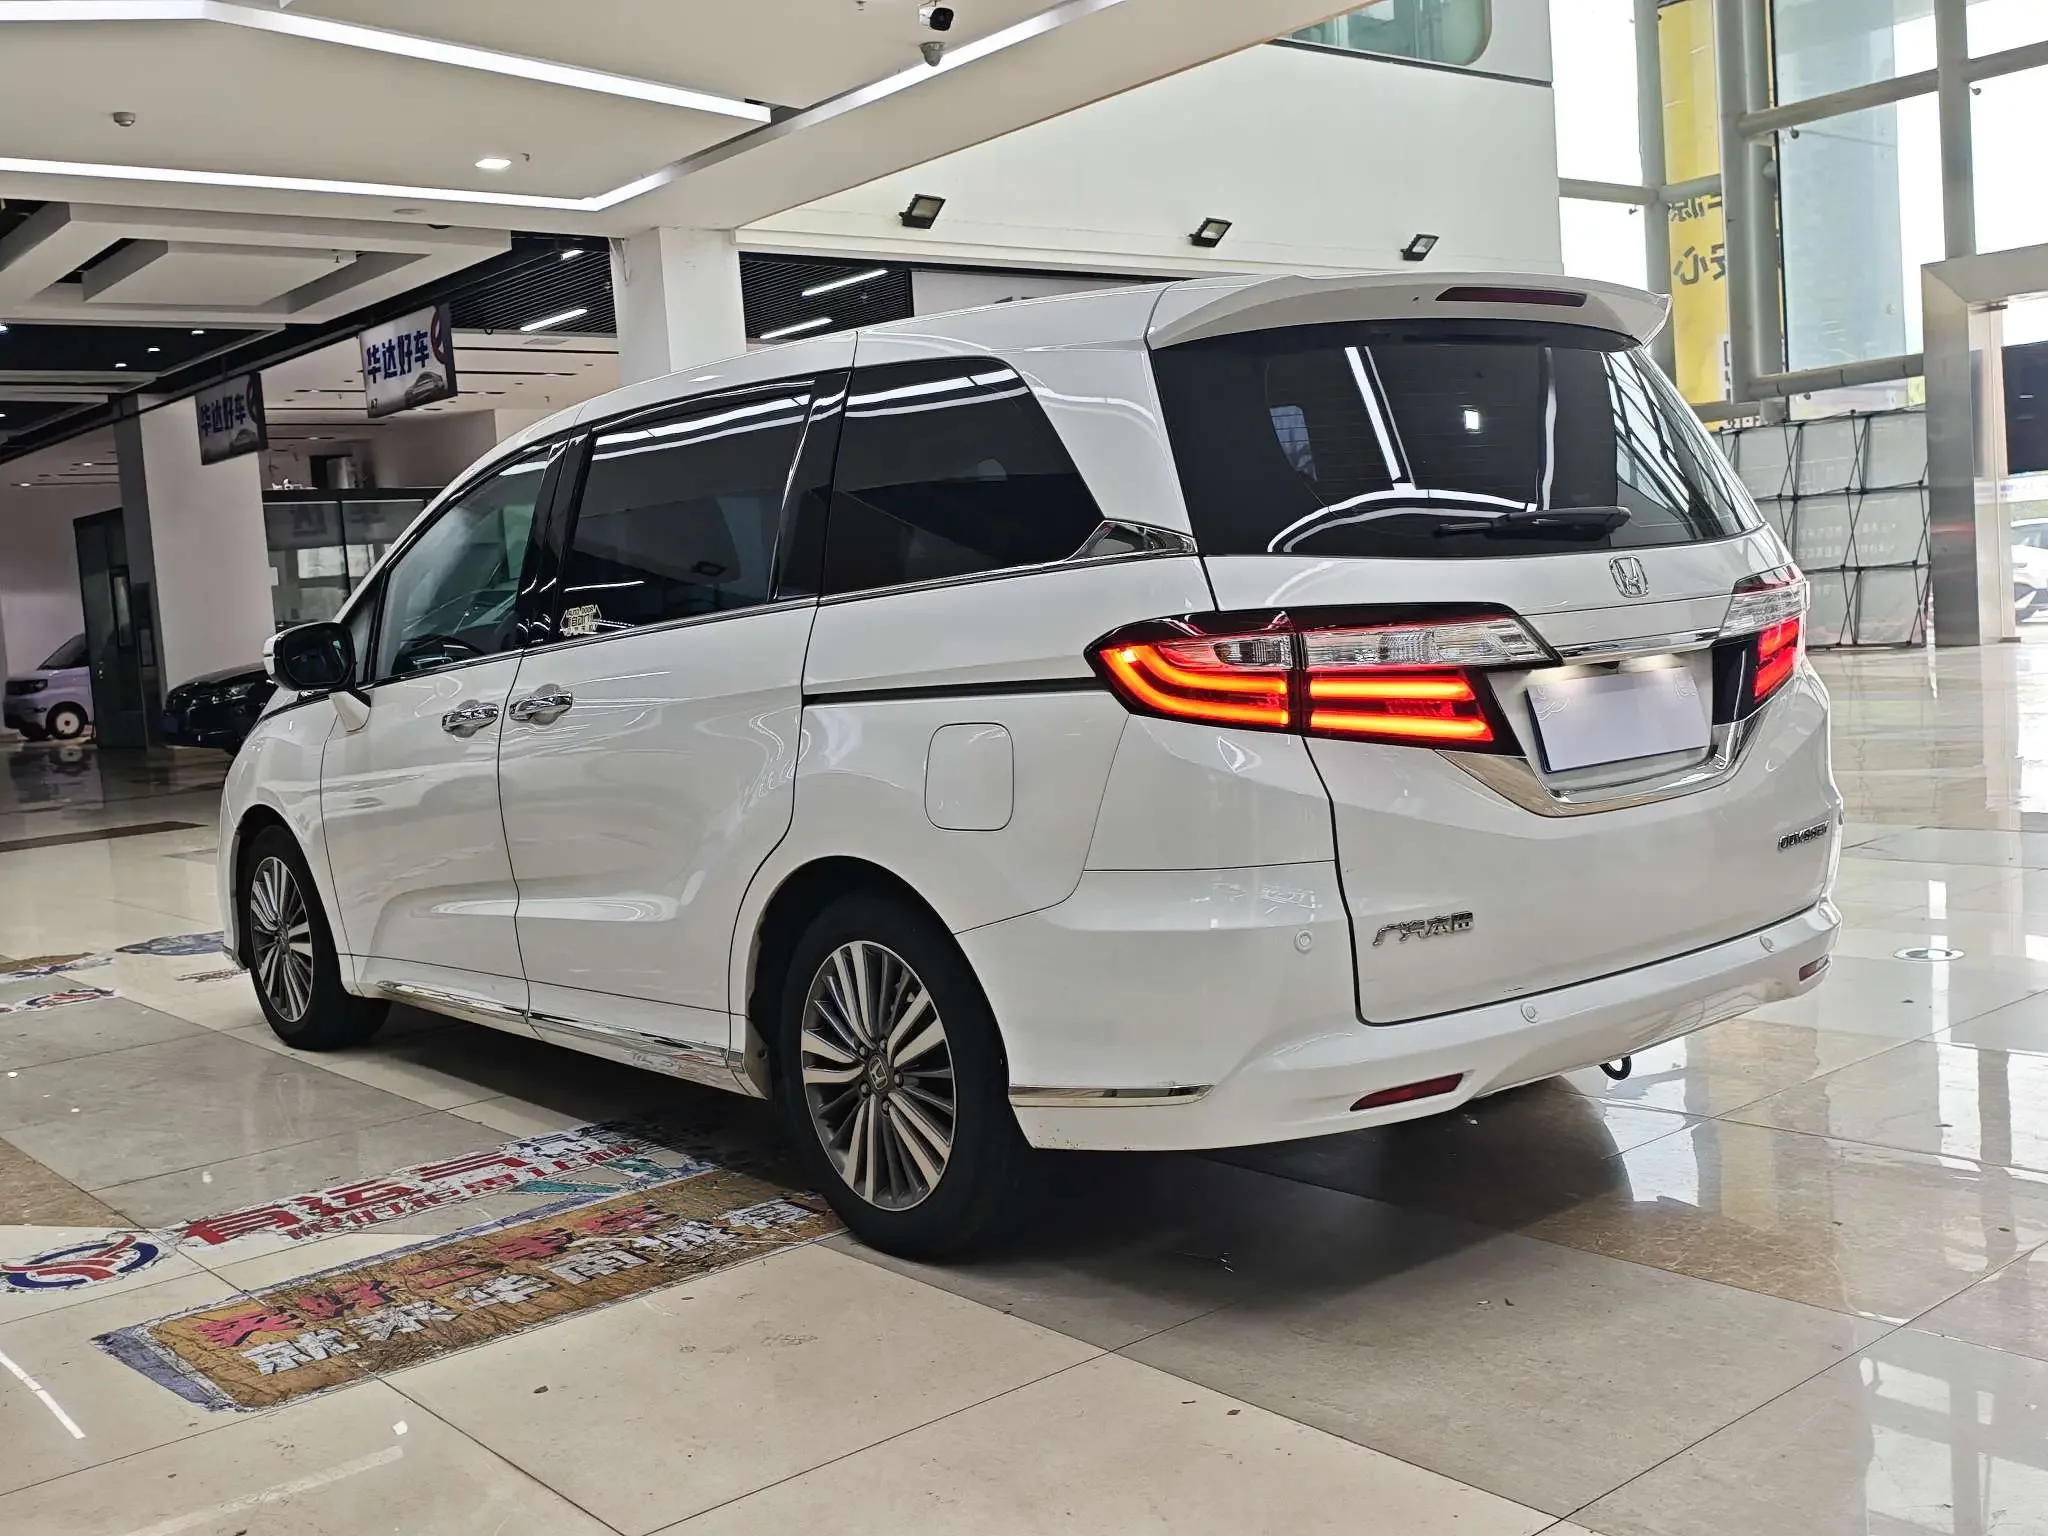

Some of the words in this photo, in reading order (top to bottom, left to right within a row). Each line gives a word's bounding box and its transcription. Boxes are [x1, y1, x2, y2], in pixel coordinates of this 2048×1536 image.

[367, 330, 430, 384] 华达好车
[200, 393, 249, 437] 华达好车
[1777, 820, 1830, 849] ODYSSEY
[1372, 911, 1474, 947] 广汽本田
